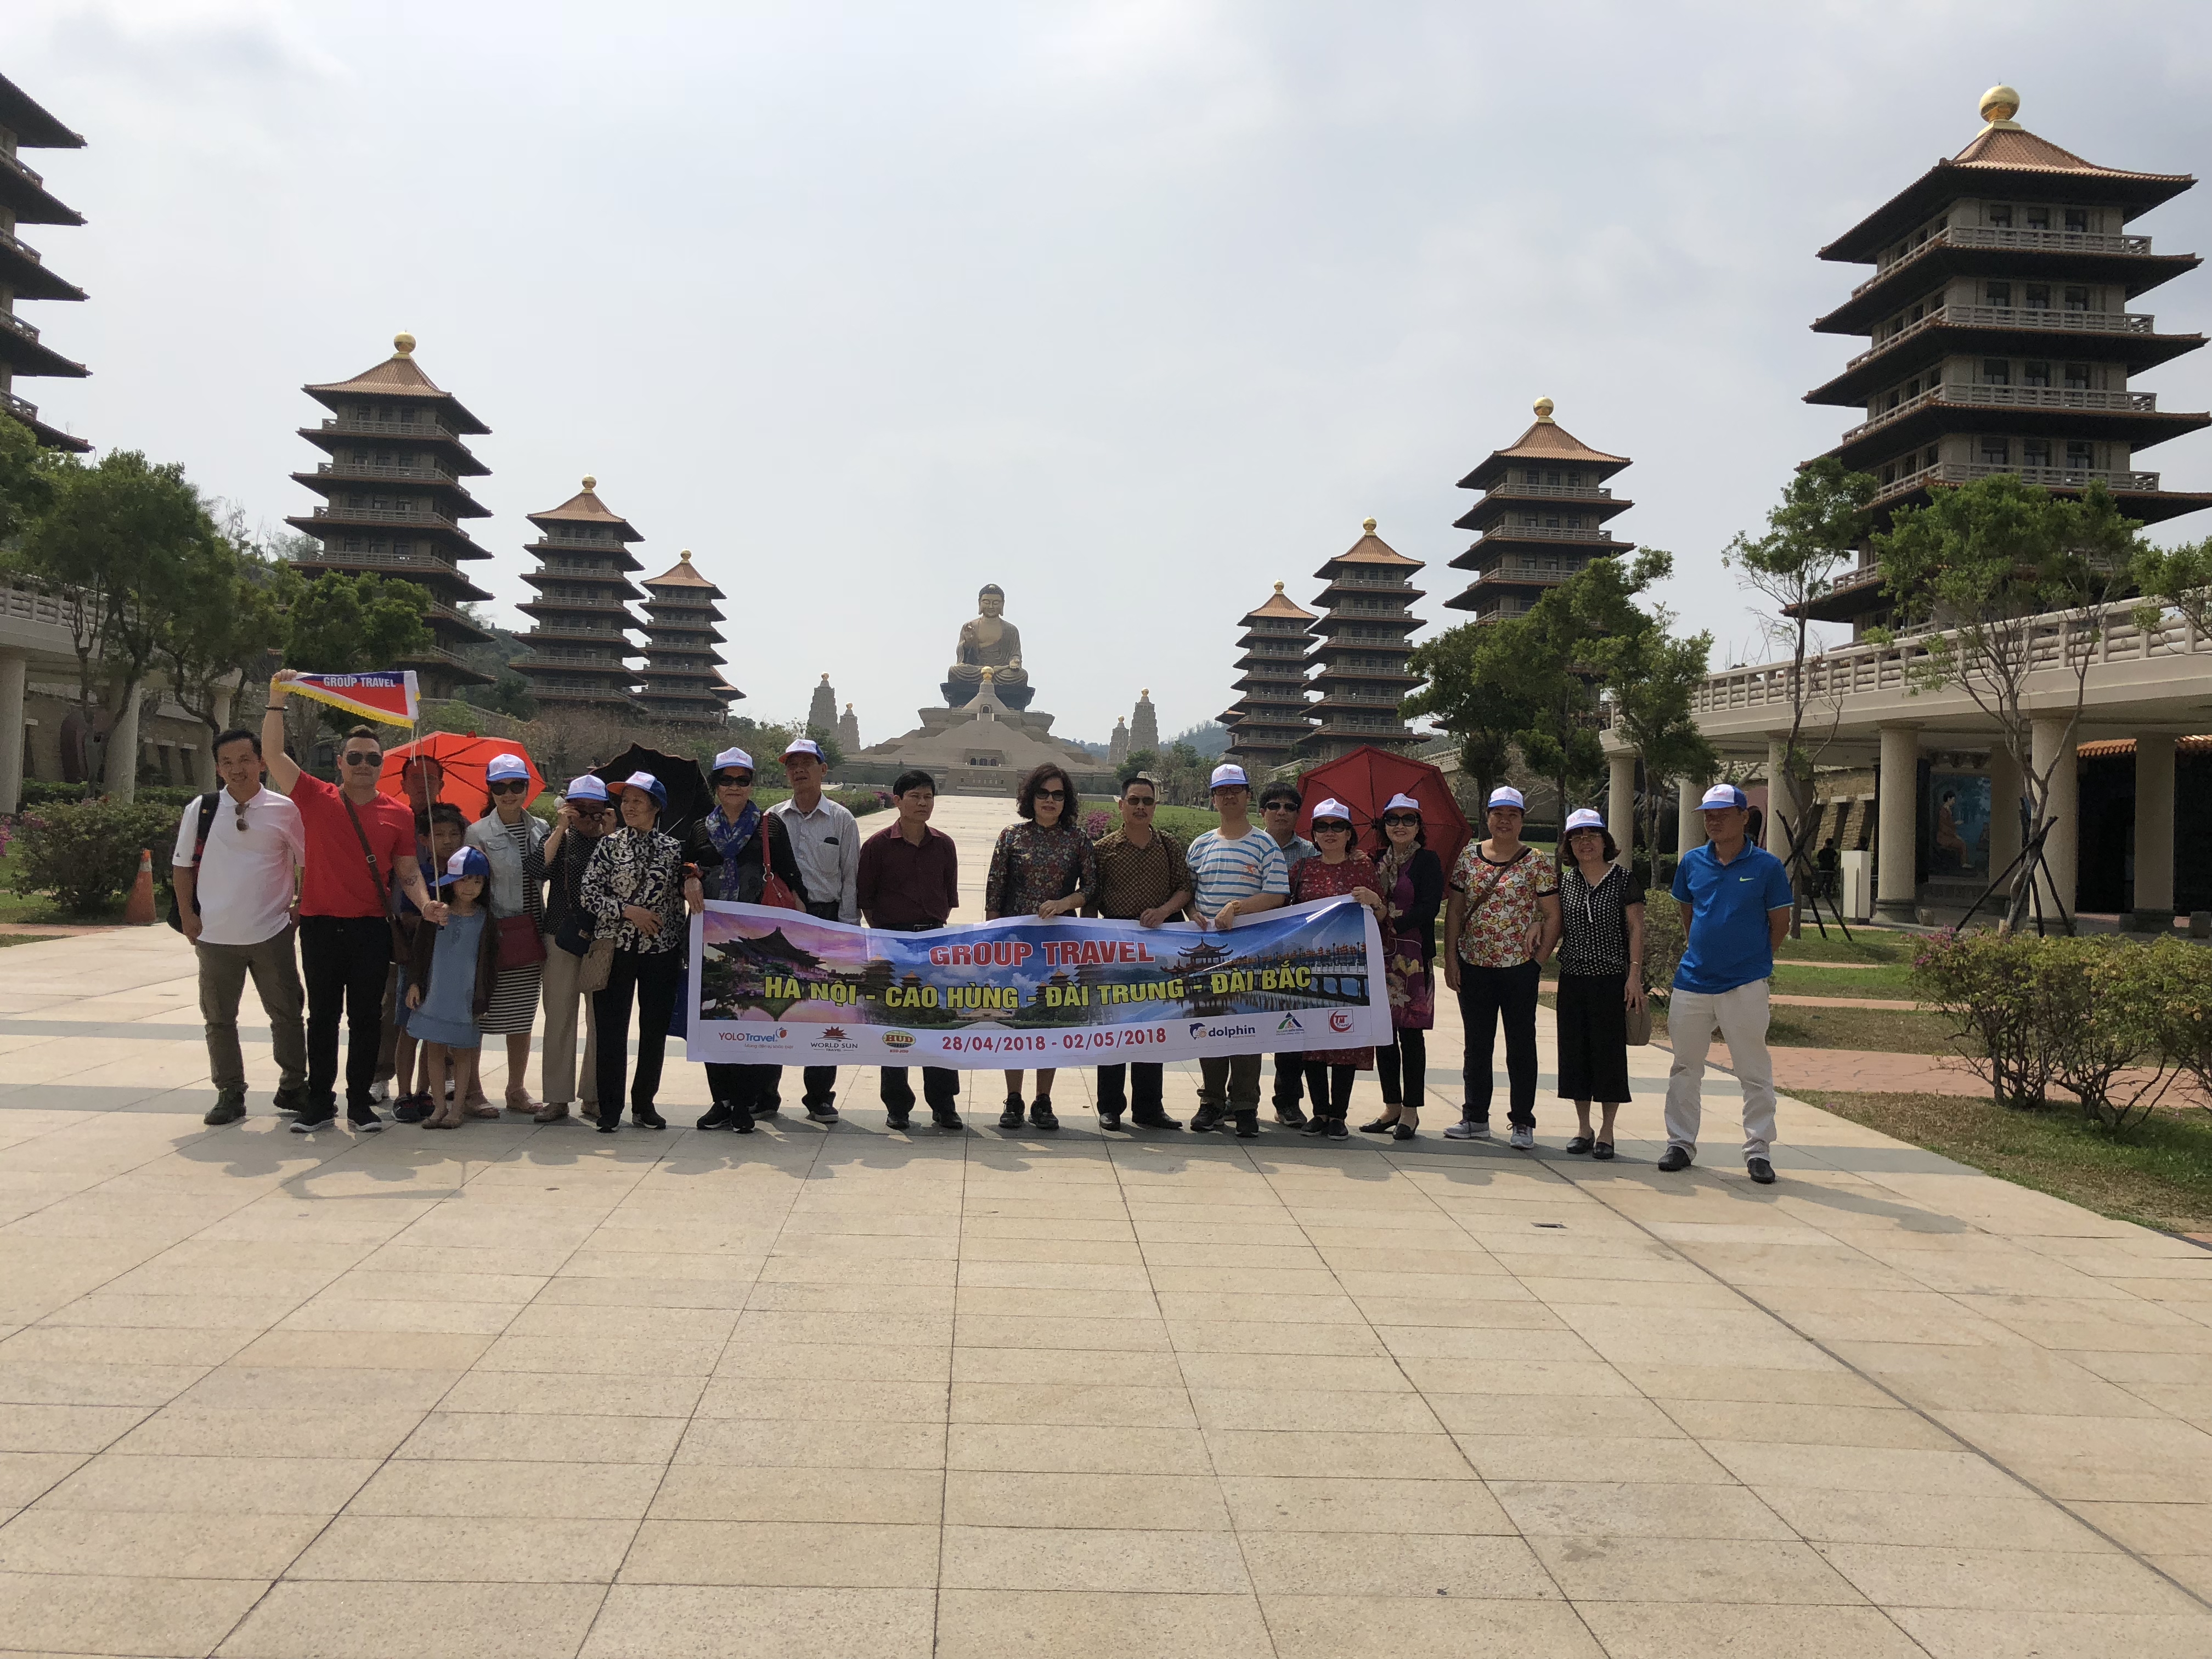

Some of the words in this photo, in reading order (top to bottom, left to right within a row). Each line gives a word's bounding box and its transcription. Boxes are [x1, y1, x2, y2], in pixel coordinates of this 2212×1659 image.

[324, 676, 358, 687] GROUP
[360, 677, 396, 687] TRAVEL
[929, 941, 1033, 967] GROUP
[1041, 940, 1156, 966] TRAVEL
[764, 975, 801, 999] HÀ
[809, 980, 857, 1006] NỘI
[885, 986, 939, 1008] CAO
[946, 983, 1019, 1009] HÙNG
[1045, 981, 1089, 1008] ĐÀI
[1097, 978, 1184, 1005] TRUNG
[1210, 968, 1254, 995] ĐÀI
[1262, 959, 1312, 990] BẮC
[885, 1034, 913, 1043] HUD
[942, 1036, 1046, 1051] 28/04/2018
[1063, 1028, 1166, 1051] 02/05/2018
[1208, 1024, 1255, 1038] dolphin
